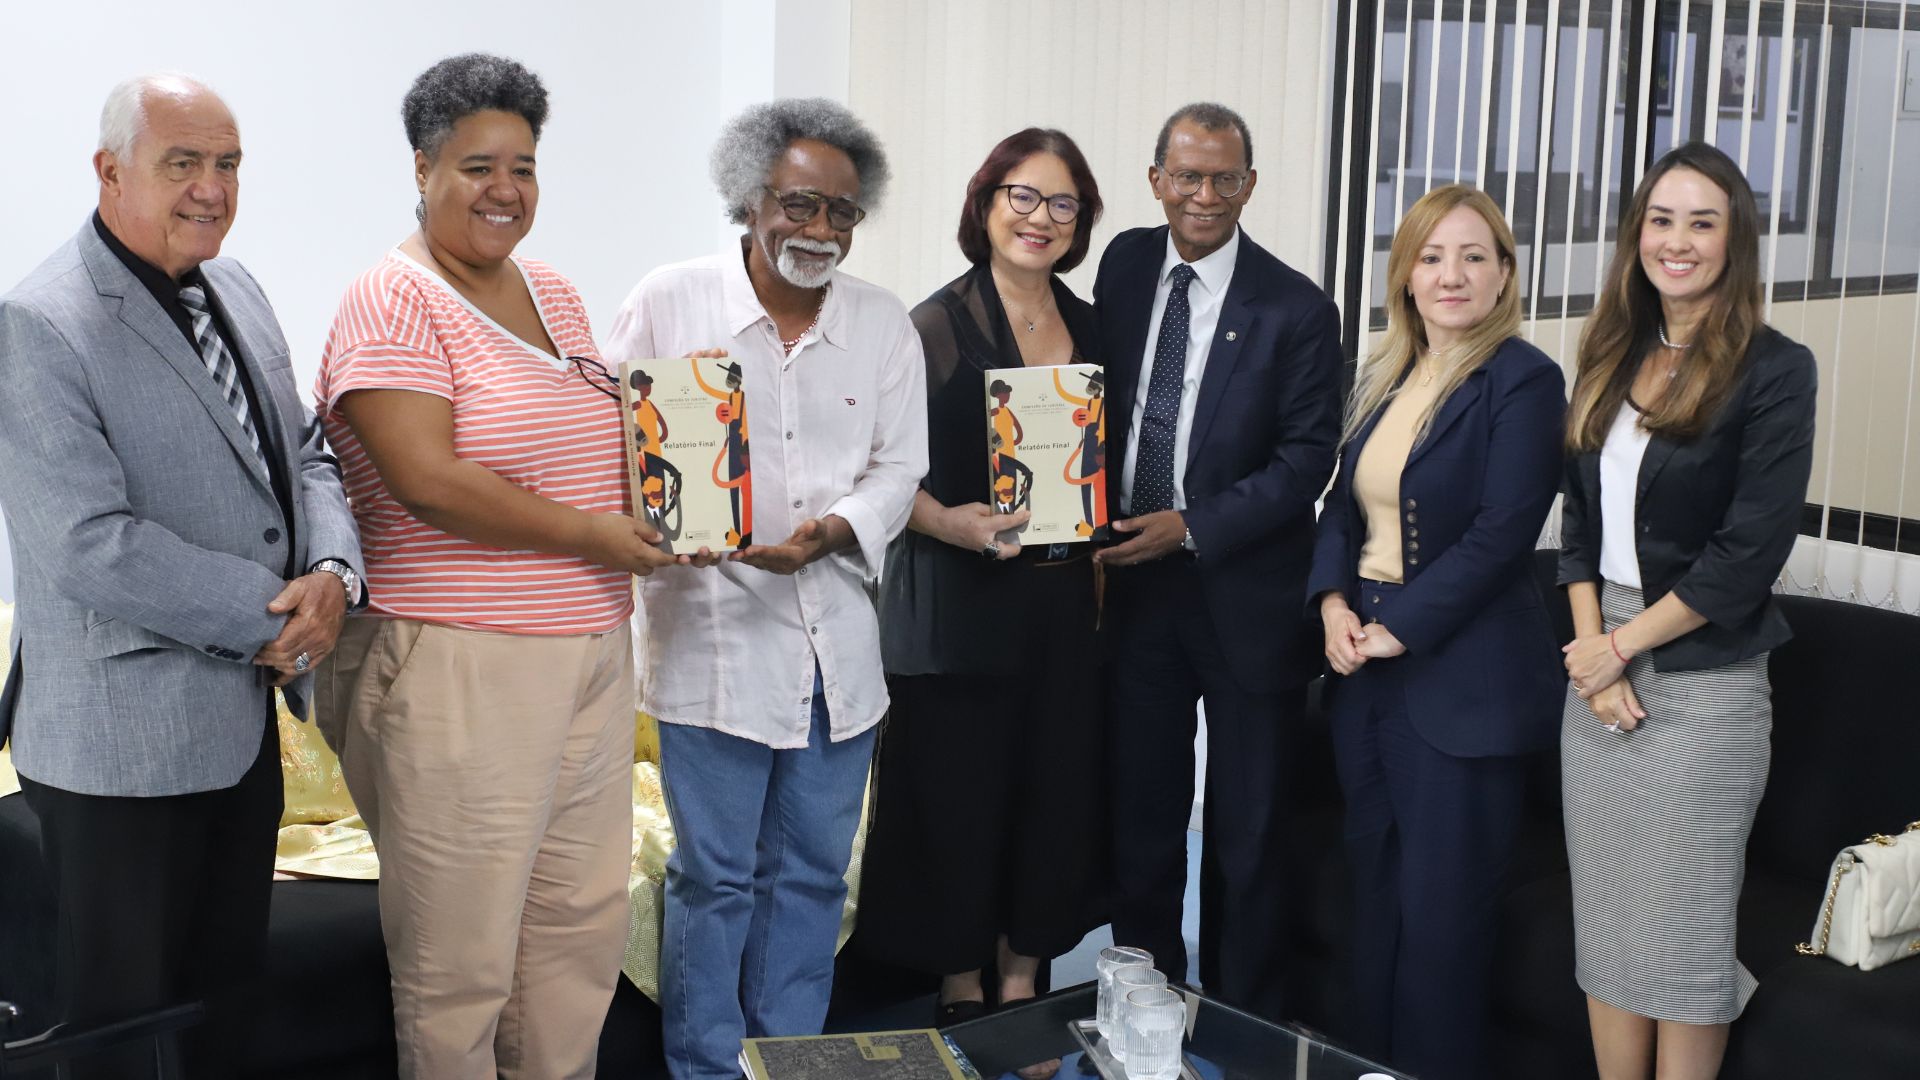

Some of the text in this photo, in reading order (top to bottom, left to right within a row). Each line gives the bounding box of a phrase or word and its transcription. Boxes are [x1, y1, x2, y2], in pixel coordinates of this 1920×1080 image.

[663, 440, 697, 449] Relatório
[1018, 441, 1070, 451] Relatório Final
